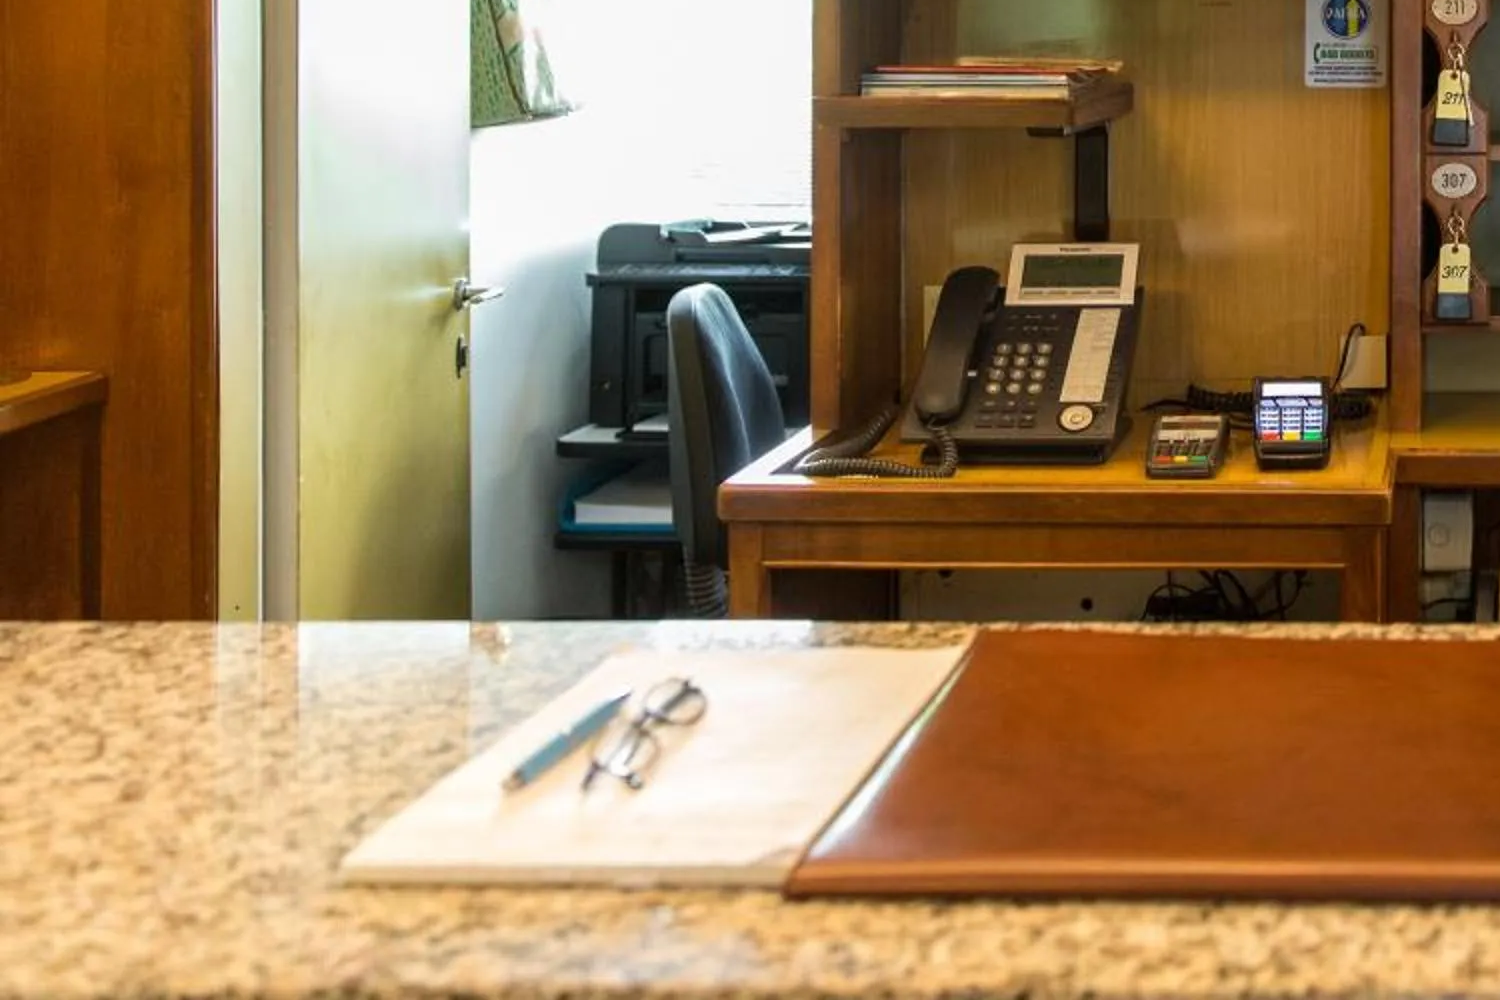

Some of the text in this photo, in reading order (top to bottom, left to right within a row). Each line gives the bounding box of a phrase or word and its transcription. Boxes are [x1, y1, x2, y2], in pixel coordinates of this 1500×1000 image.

[1446, 0, 1464, 14] 211
[1442, 173, 1467, 188] 307
[1442, 265, 1467, 279] 307
